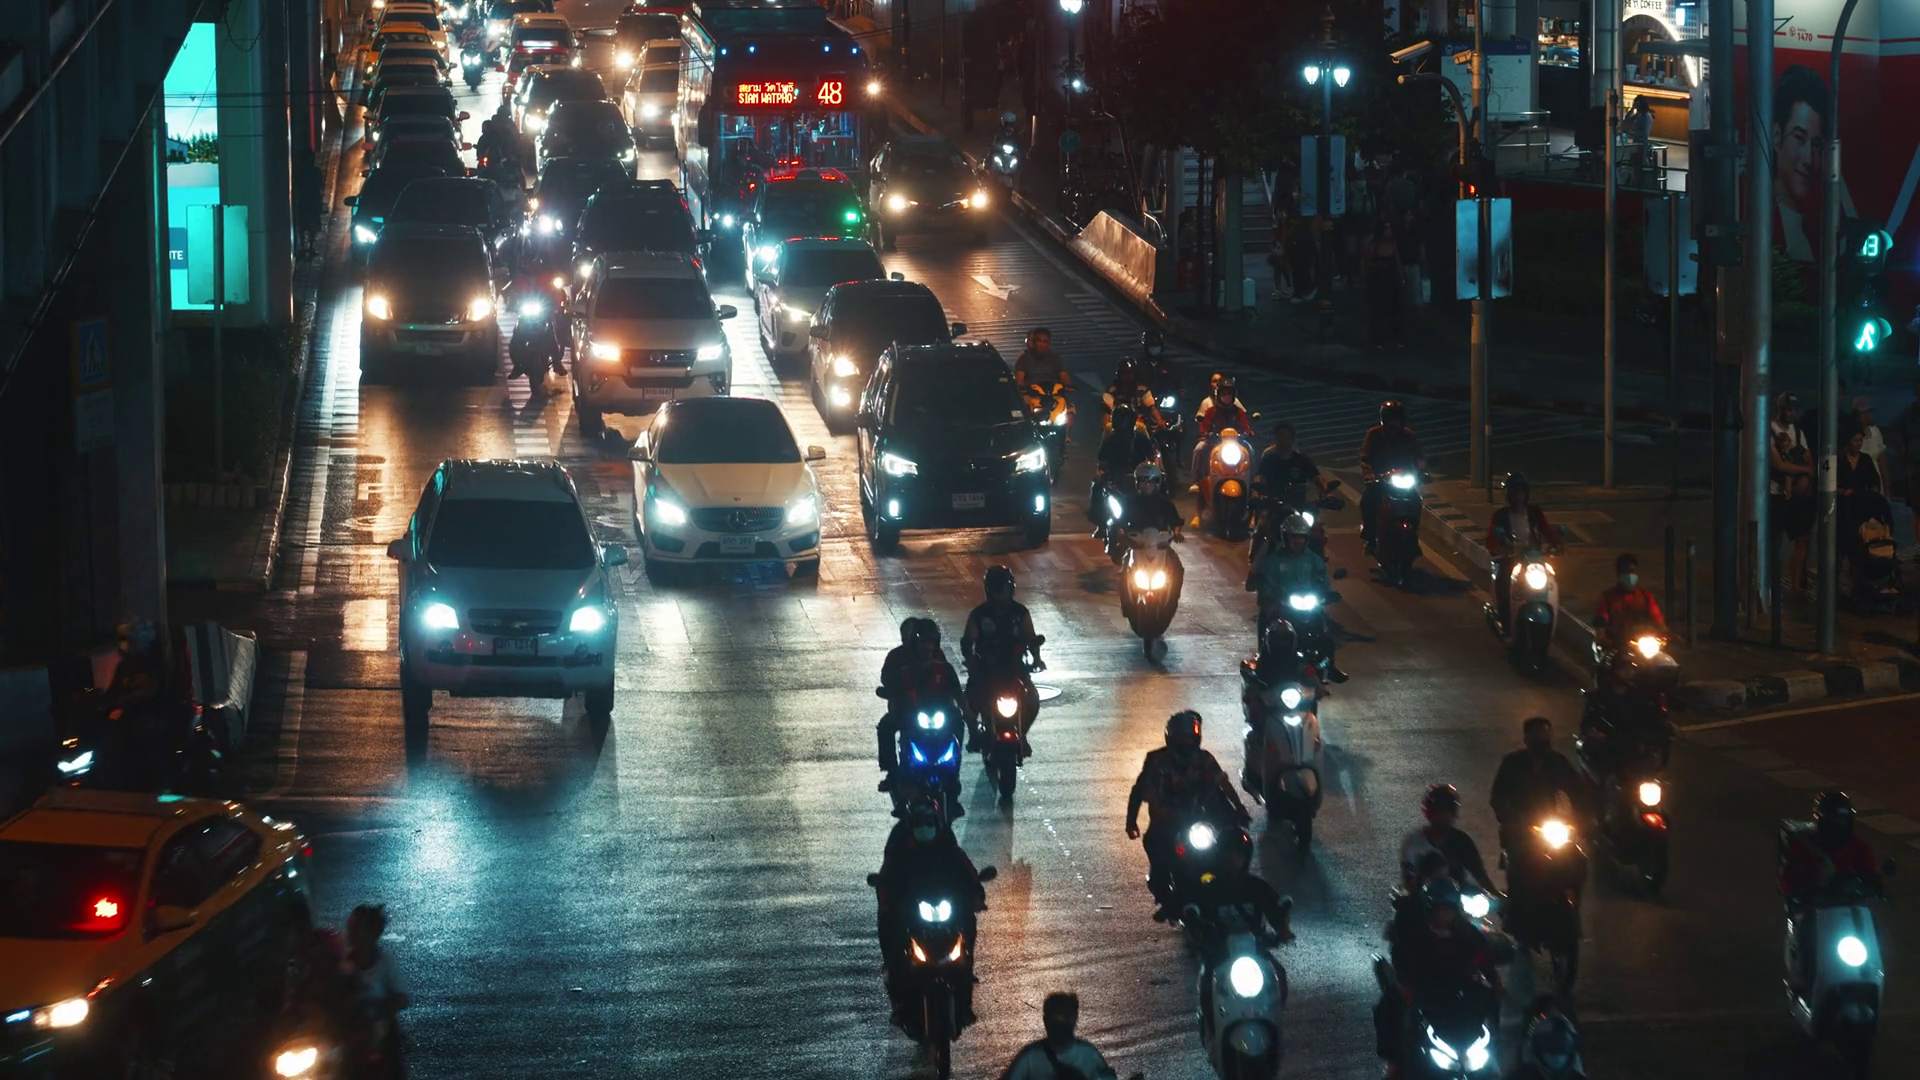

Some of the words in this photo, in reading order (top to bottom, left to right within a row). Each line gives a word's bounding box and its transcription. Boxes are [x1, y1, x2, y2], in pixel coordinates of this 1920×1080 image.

[1797, 32, 1813, 42] 1470
[738, 93, 758, 104] SIAM
[817, 82, 842, 104] 48
